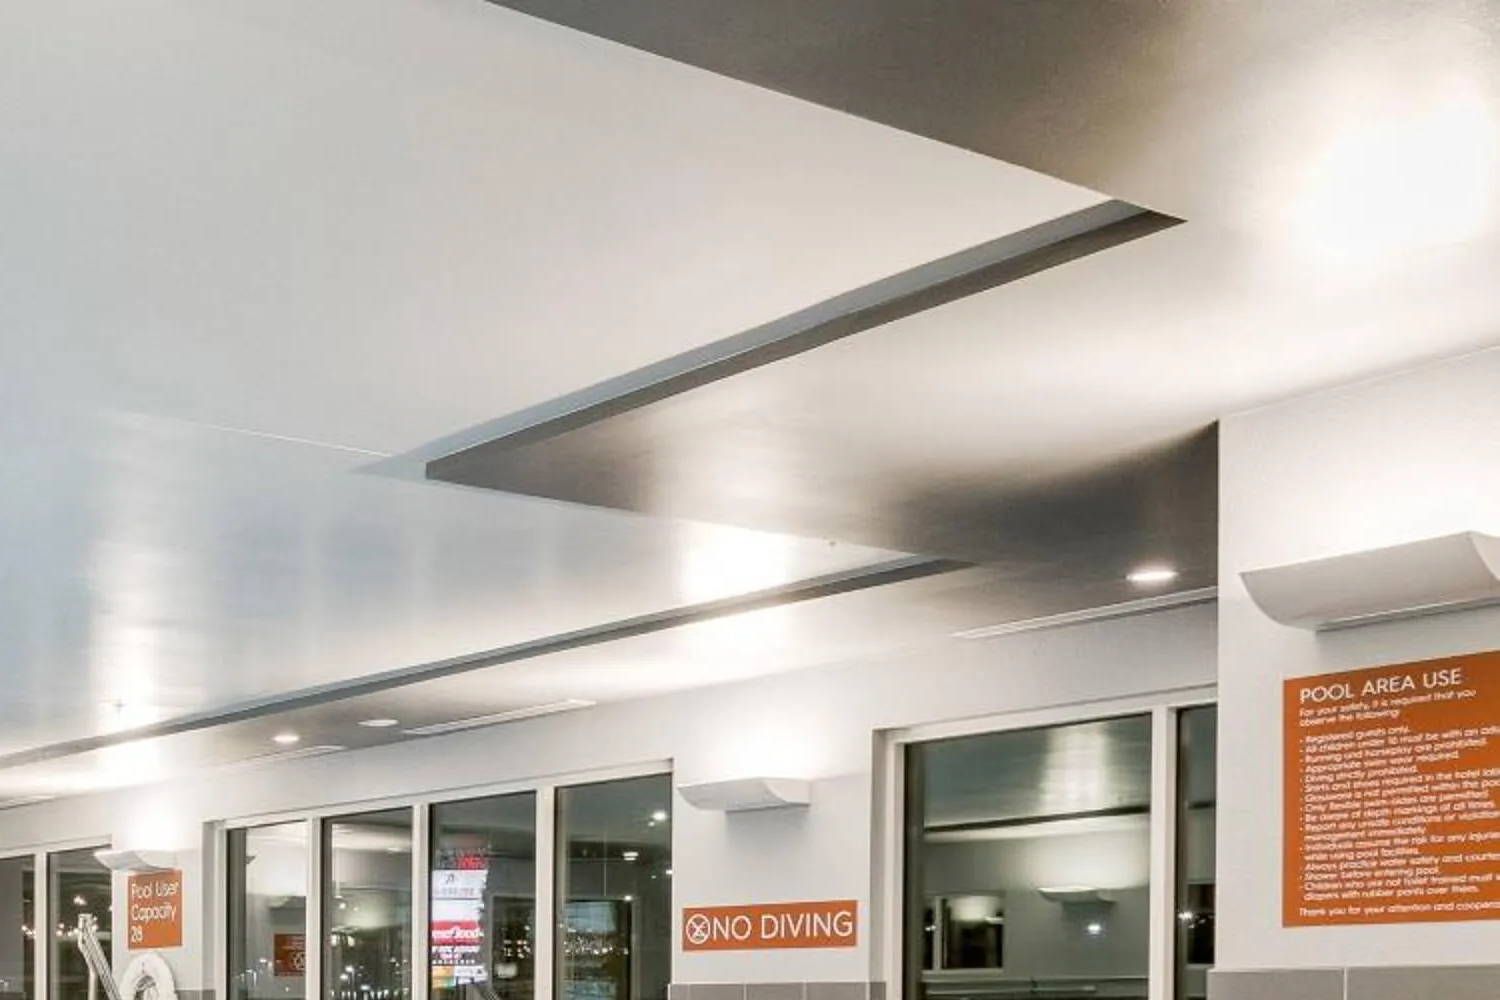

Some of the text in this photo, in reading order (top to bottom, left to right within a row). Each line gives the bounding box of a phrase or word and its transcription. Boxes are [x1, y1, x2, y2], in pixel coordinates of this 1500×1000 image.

[1300, 668, 1461, 704] POOL AREA USE
[131, 880, 180, 899] Pool User
[131, 902, 177, 923] Capacity
[712, 910, 853, 941] NO DIVING
